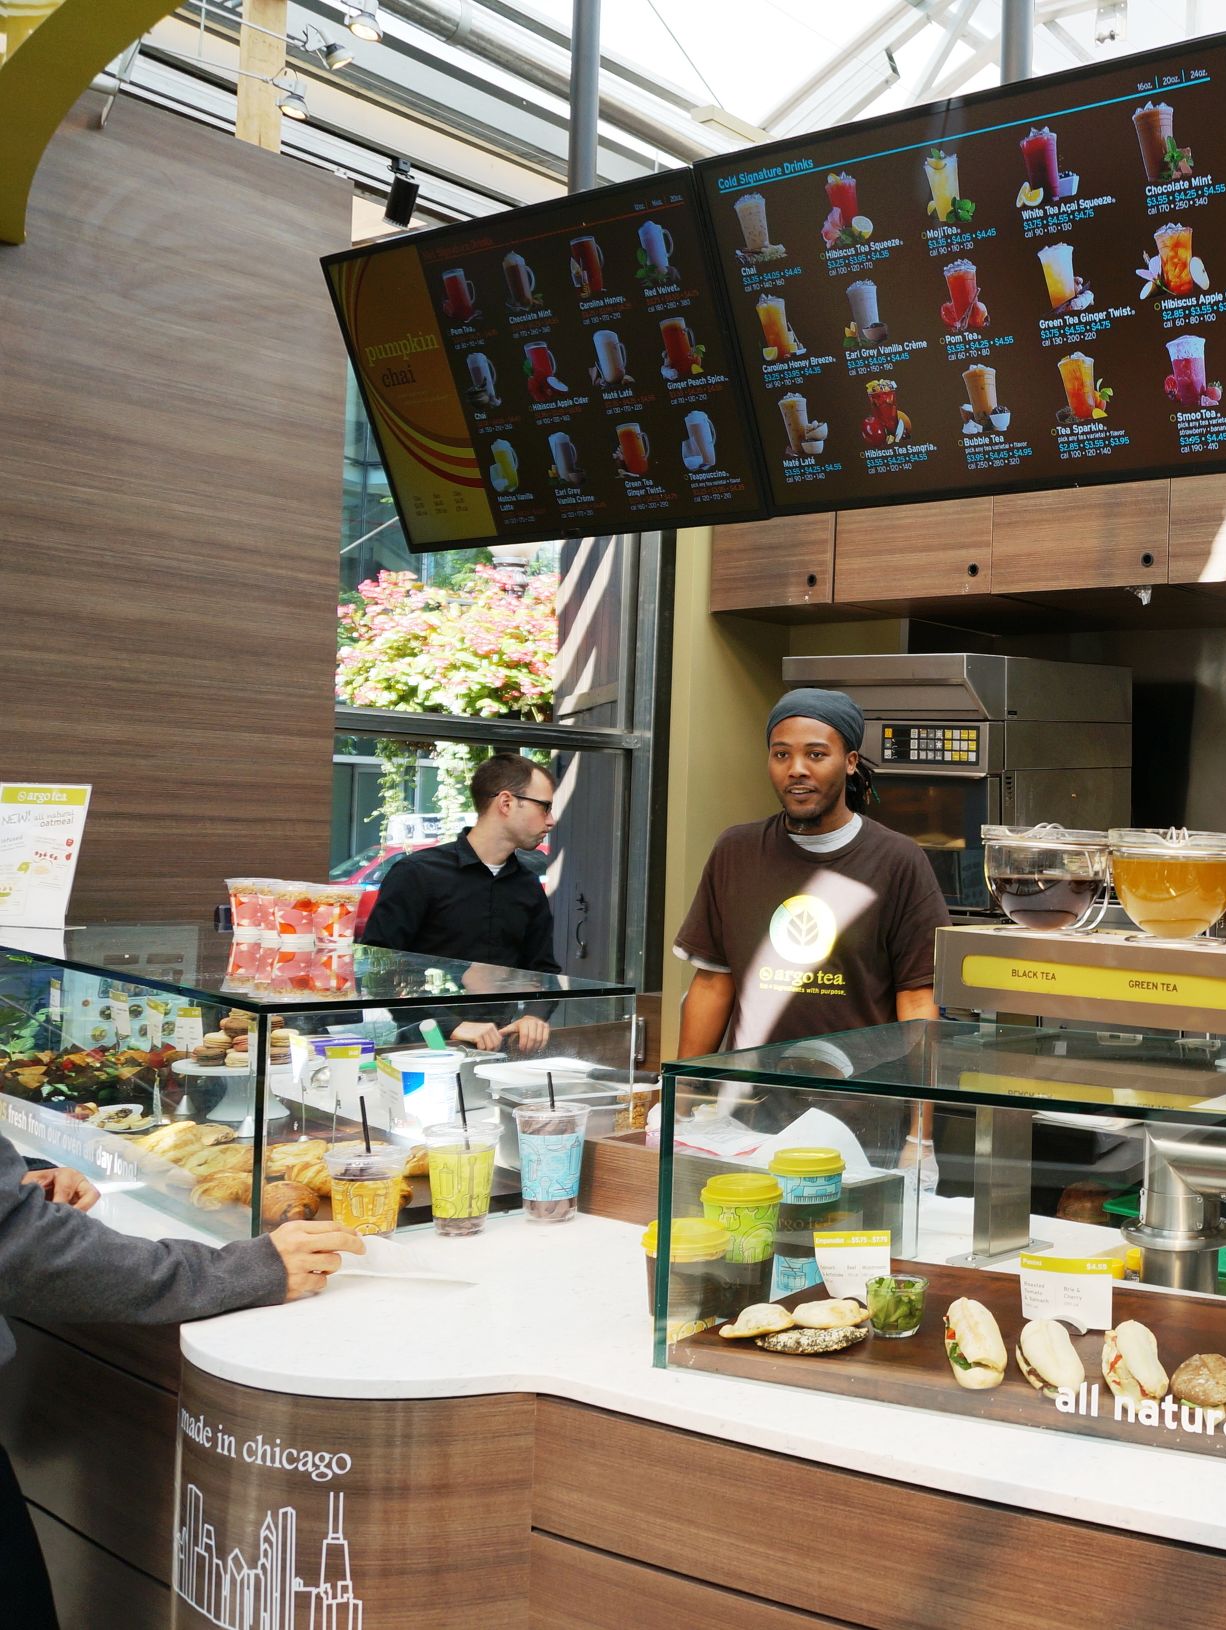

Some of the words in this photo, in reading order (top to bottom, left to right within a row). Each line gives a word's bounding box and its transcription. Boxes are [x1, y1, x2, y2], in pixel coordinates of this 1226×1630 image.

[718, 177, 737, 189] Cold
[739, 167, 782, 184] Signature
[784, 158, 814, 174] Drinks
[1145, 182, 1189, 196] Chocolate
[1191, 174, 1212, 187] Mint
[1147, 195, 1167, 206] $3.55
[1174, 189, 1196, 200] $4.25
[1204, 184, 1226, 195] $4.55
[1021, 209, 1042, 220] White
[1045, 206, 1058, 215] Tea
[1161, 297, 1196, 310] Hibiscus
[1199, 293, 1223, 306] Apple
[1039, 318, 1064, 328] Green
[1066, 315, 1079, 325] Tea
[1081, 312, 1107, 324] Ginger
[365, 333, 439, 367] pumpkin
[382, 365, 416, 388] chai
[27, 792, 50, 803] argo
[774, 968, 814, 985] argo
[1011, 969, 1038, 981] BLACK
[1041, 971, 1056, 982] TEA
[1128, 980, 1157, 992] GREEN
[1160, 982, 1178, 993] TEA
[8, 1105, 26, 1130] fresh
[28, 1113, 45, 1139] from
[96, 1146, 113, 1175] day
[1055, 1382, 1099, 1416] all
[181, 1408, 212, 1447] made
[216, 1425, 236, 1458] in
[243, 1435, 351, 1482] chicago
